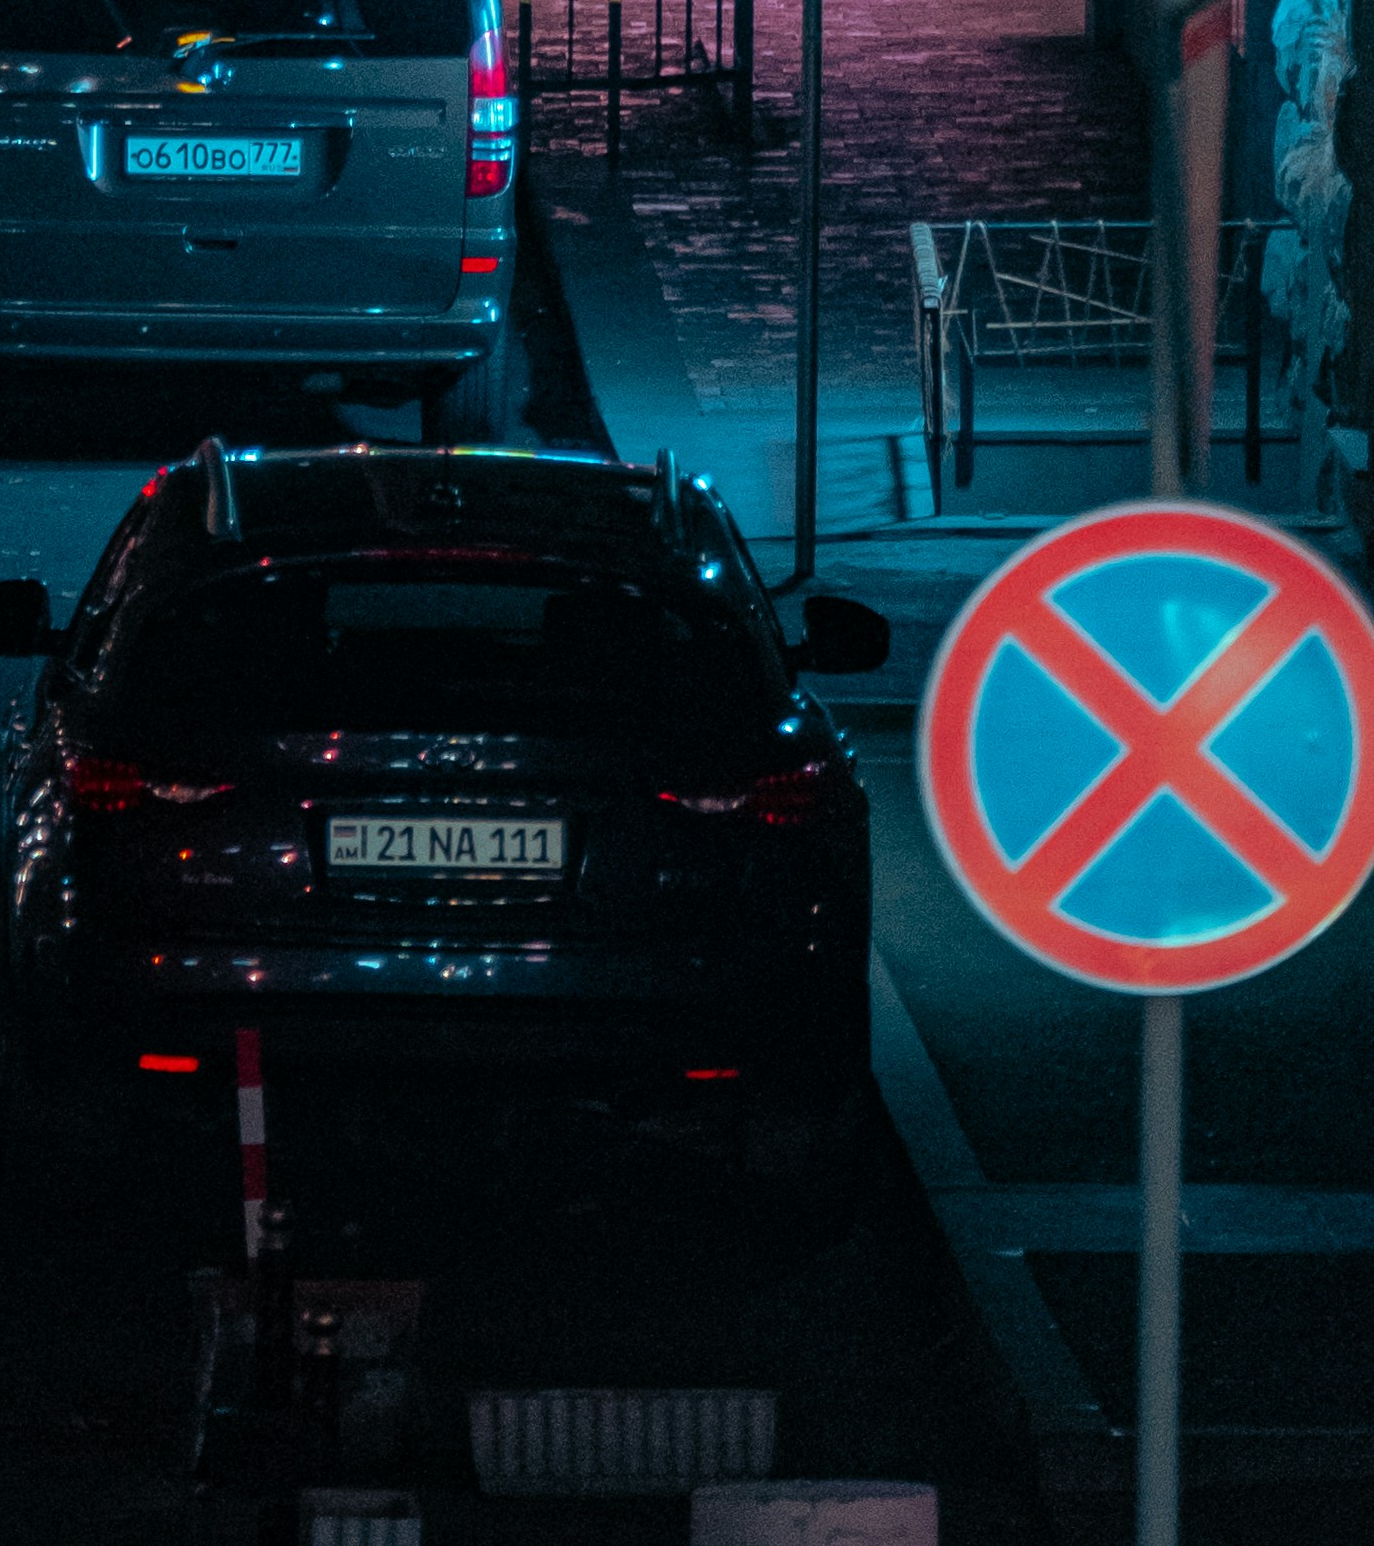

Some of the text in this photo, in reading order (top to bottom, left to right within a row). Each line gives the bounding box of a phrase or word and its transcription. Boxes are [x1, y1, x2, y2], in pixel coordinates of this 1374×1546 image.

[252, 142, 294, 164] 777
[334, 848, 358, 860] AM
[377, 826, 550, 864] 21 NA 111
